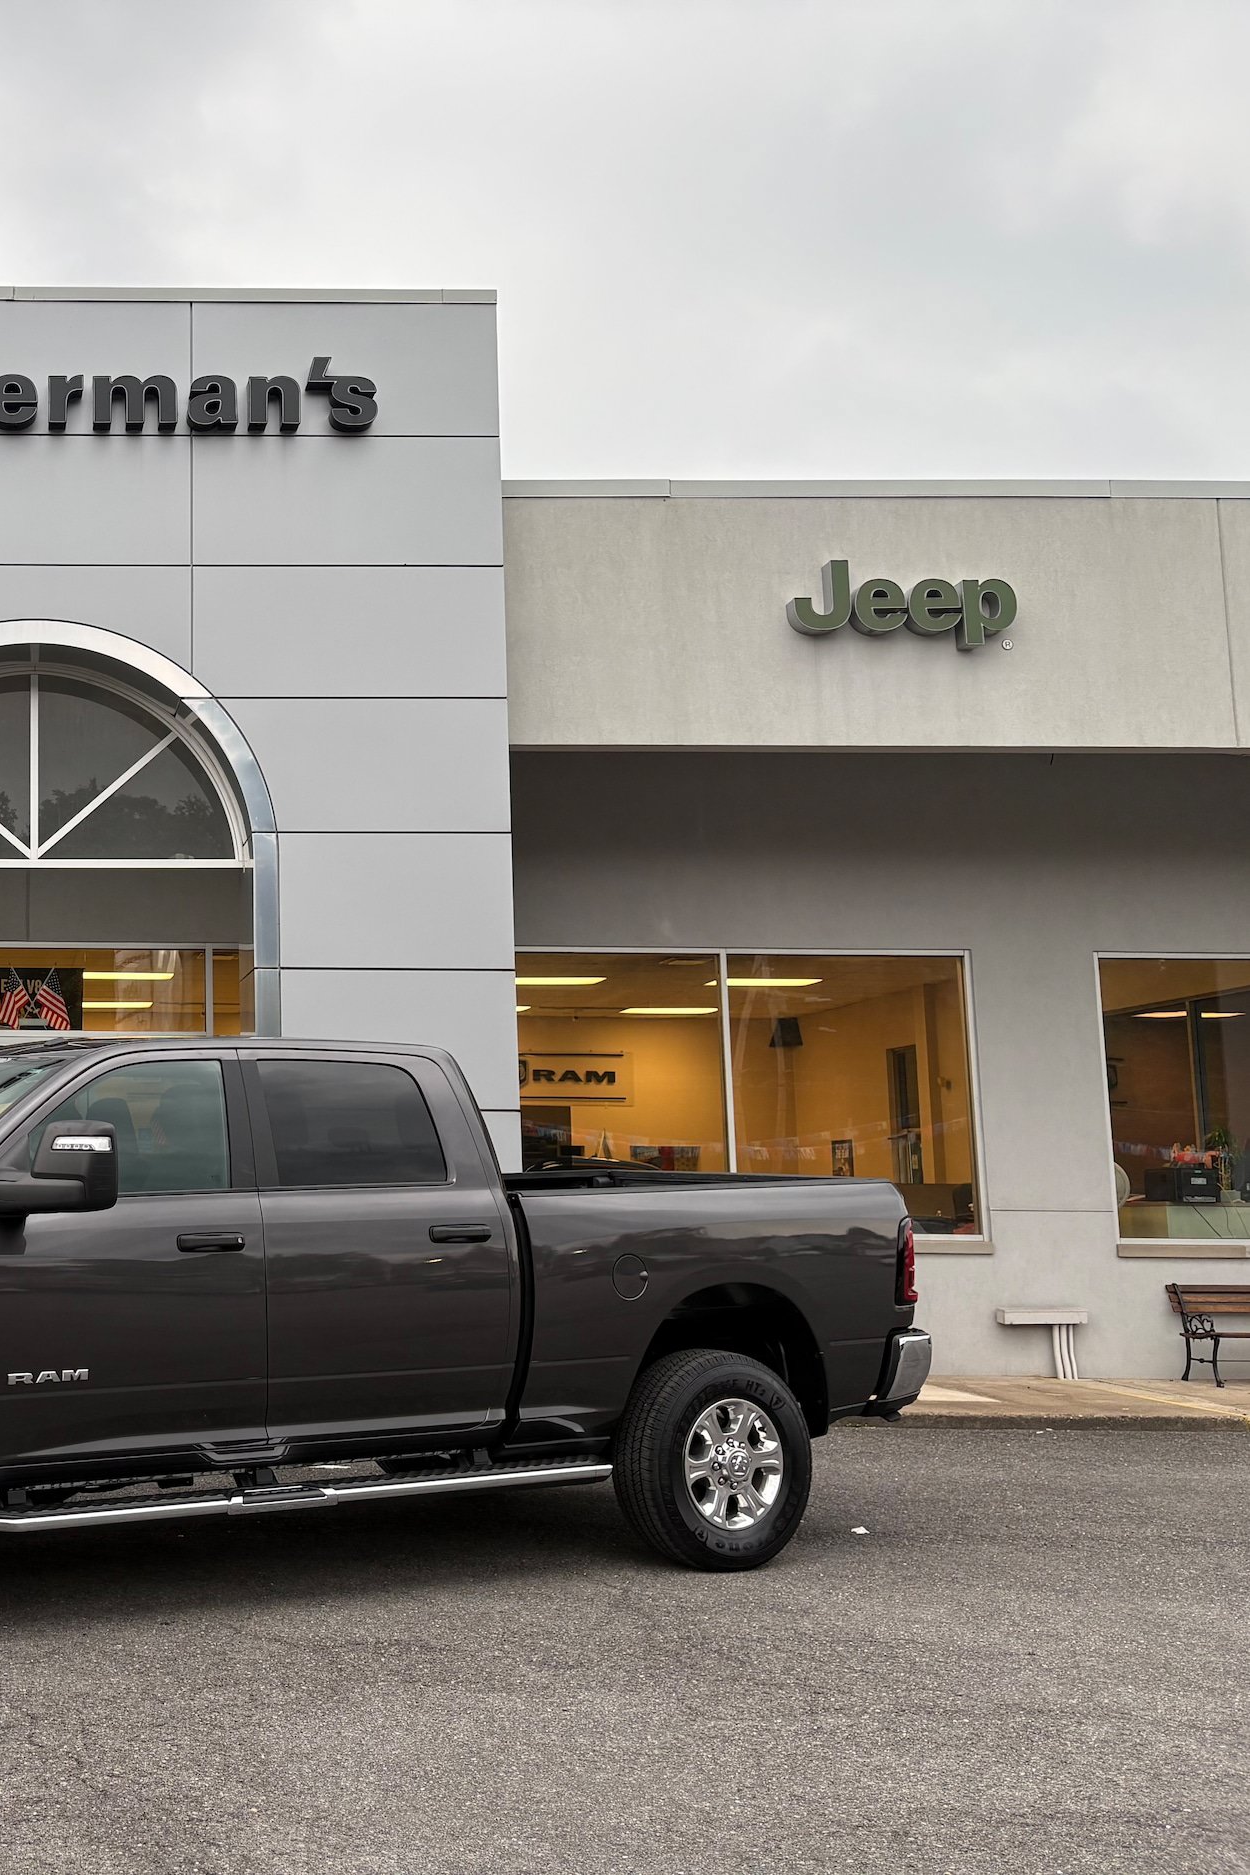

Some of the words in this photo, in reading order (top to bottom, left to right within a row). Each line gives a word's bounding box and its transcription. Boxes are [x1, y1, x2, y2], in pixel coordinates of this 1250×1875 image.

[786, 560, 1018, 650] Jeep
[532, 1069, 616, 1084] RAM
[7, 1368, 89, 1386] RAM
